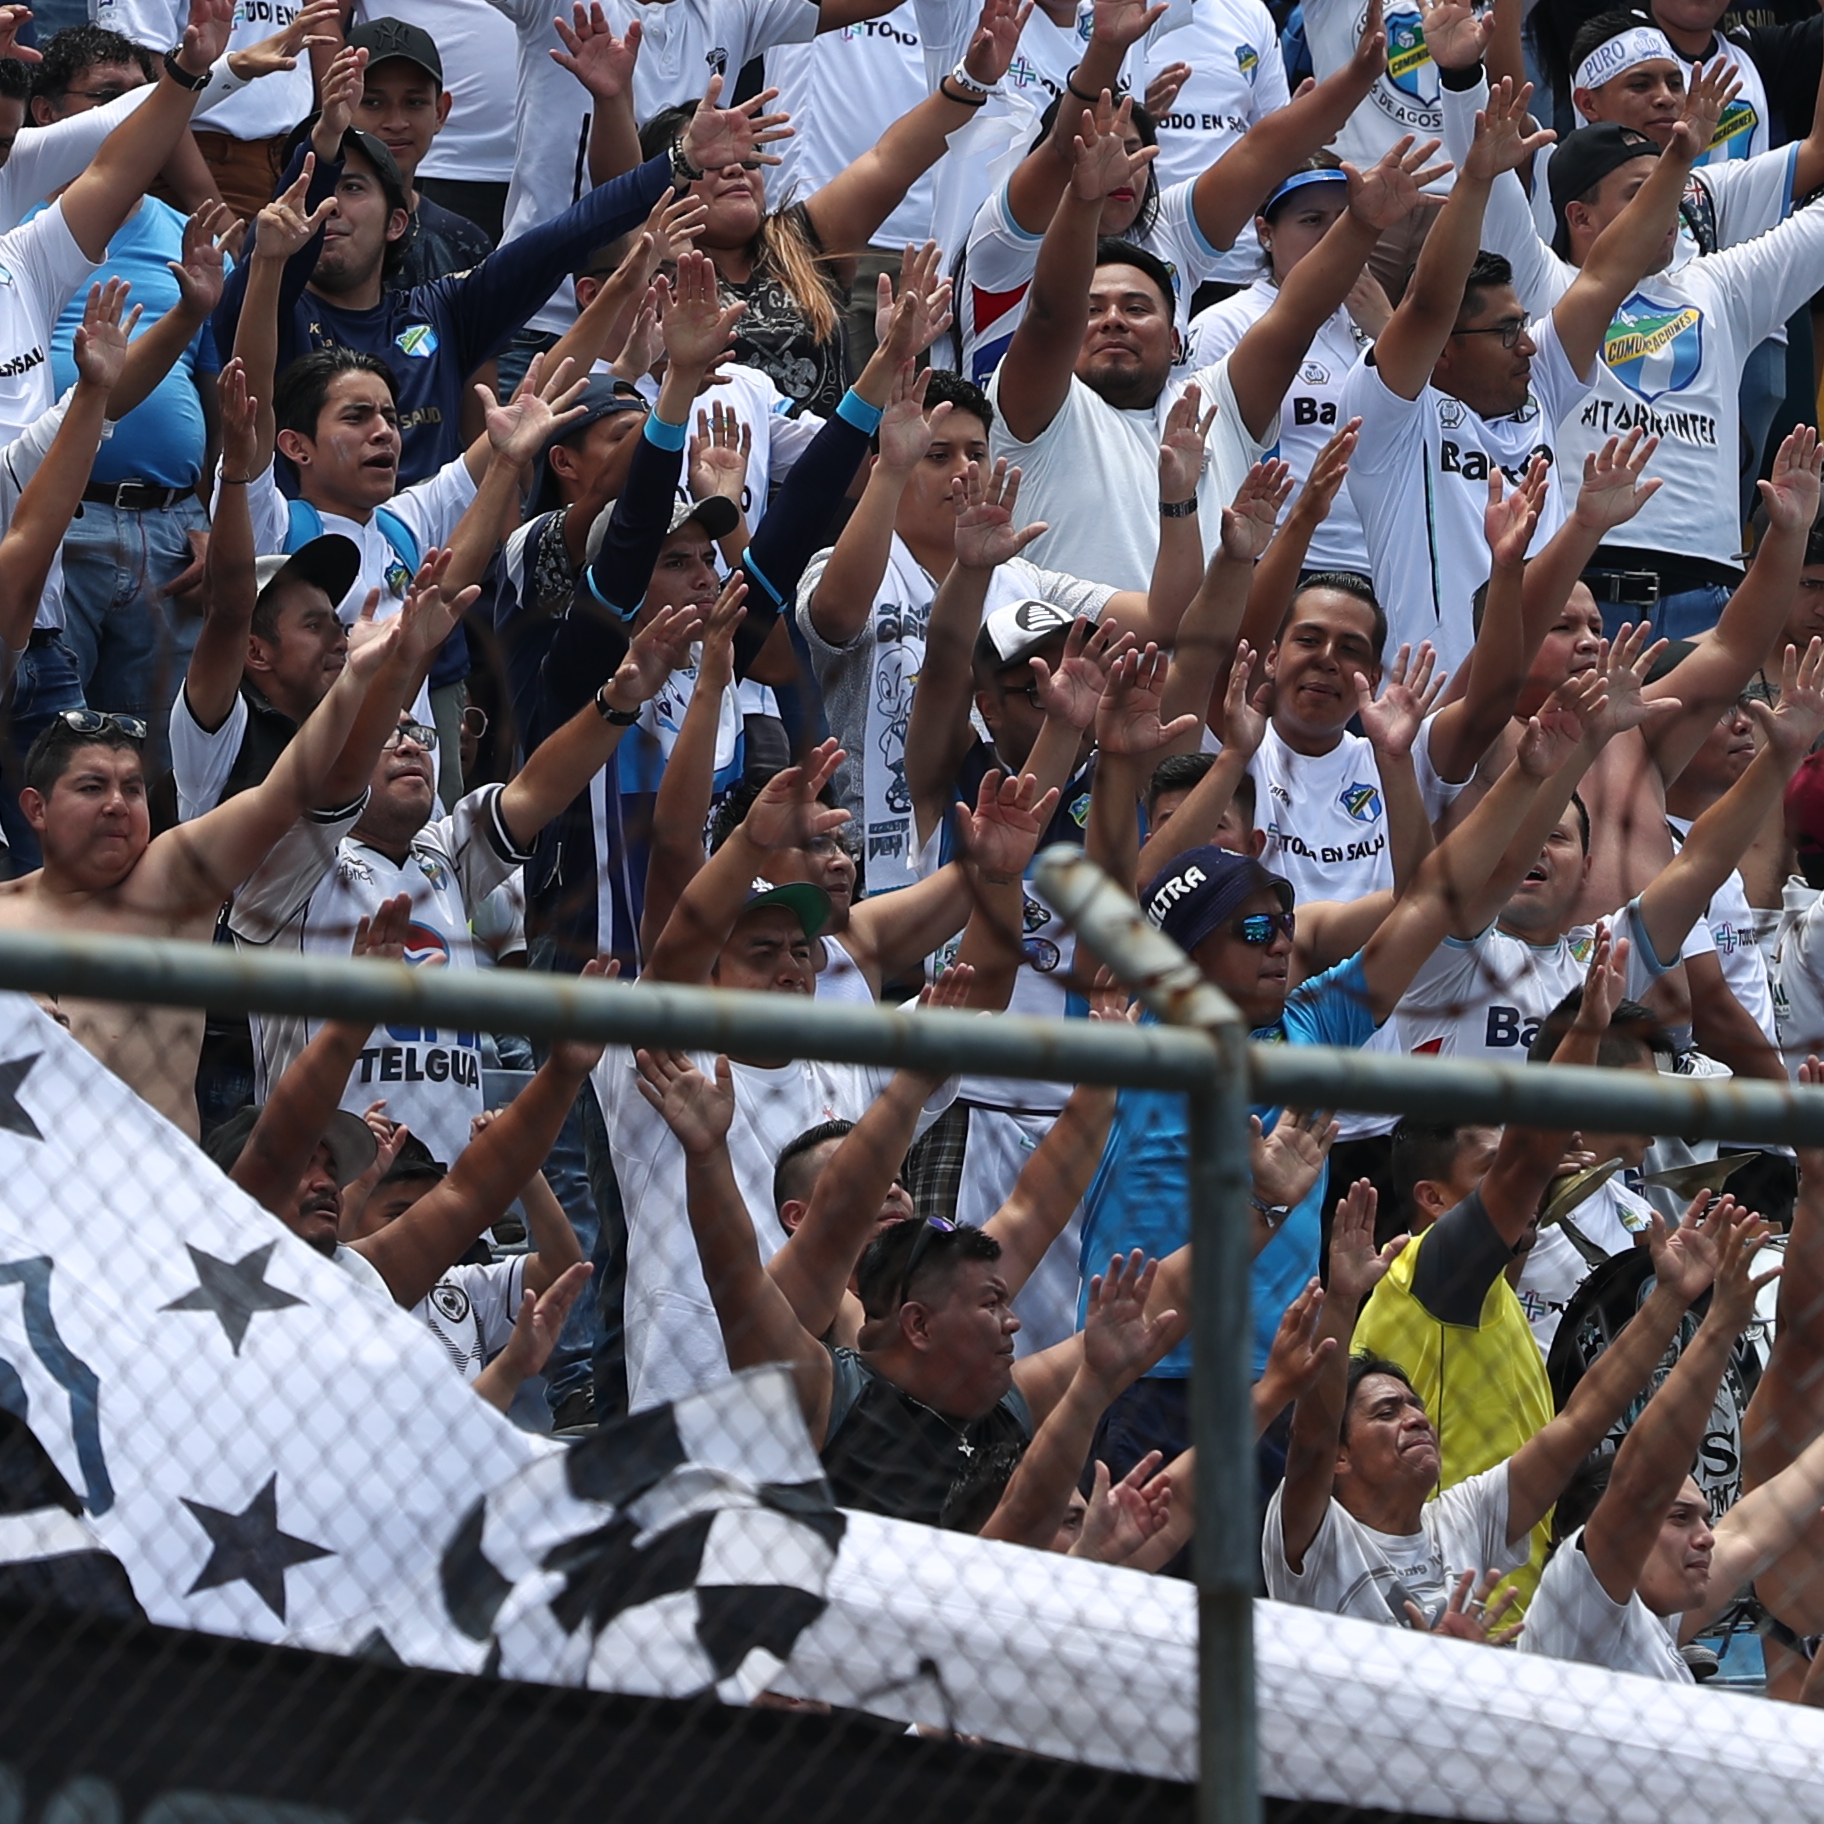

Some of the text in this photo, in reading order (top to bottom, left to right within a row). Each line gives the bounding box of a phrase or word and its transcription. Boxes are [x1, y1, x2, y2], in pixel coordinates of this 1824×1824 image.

[1584, 40, 1627, 77] PURO
[1203, 113, 1223, 130] EN
[1378, 97, 1443, 128] DE AGOST
[1606, 310, 1693, 363] COMUNICACIONES
[1321, 846, 1345, 863] EN
[356, 1046, 480, 1089] TELGUA
